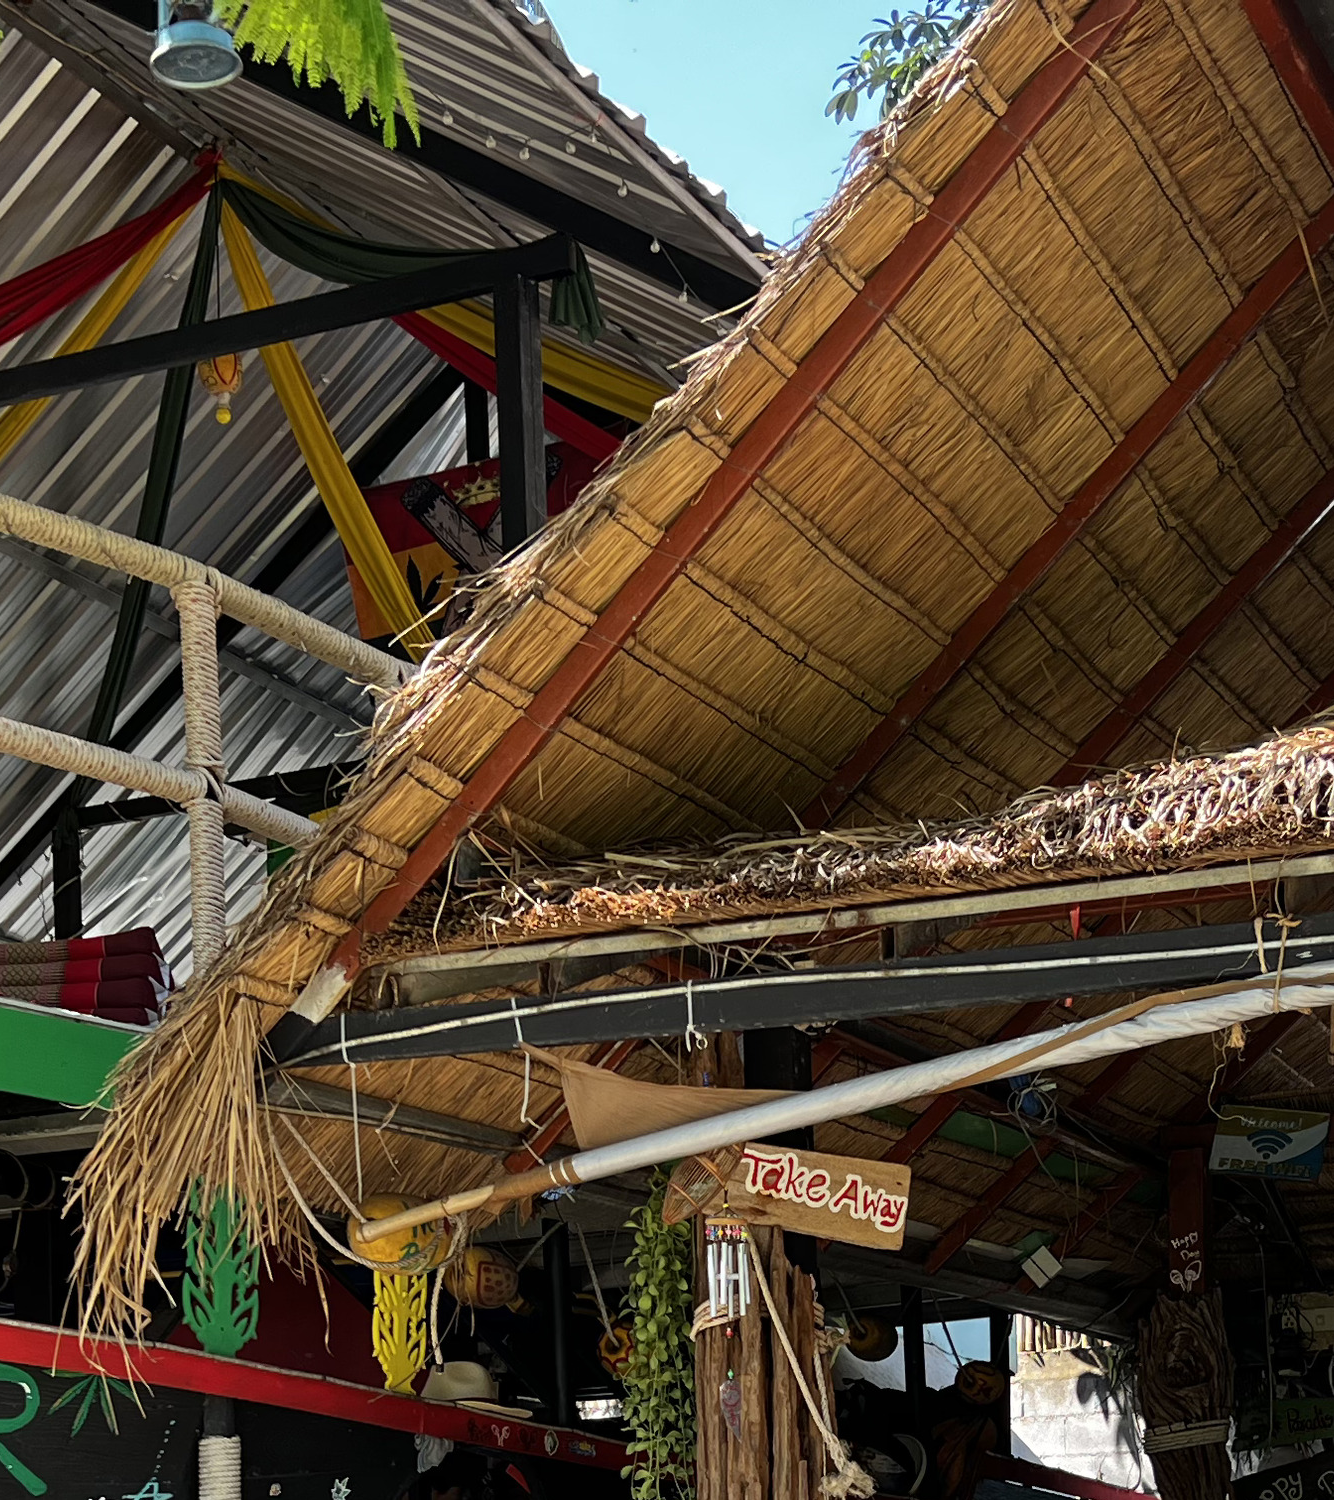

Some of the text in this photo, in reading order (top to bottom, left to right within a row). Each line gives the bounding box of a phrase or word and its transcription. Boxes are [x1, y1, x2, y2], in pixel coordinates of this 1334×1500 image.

[1219, 1158, 1266, 1173] FREE
[742, 1150, 907, 1230] Take Away
